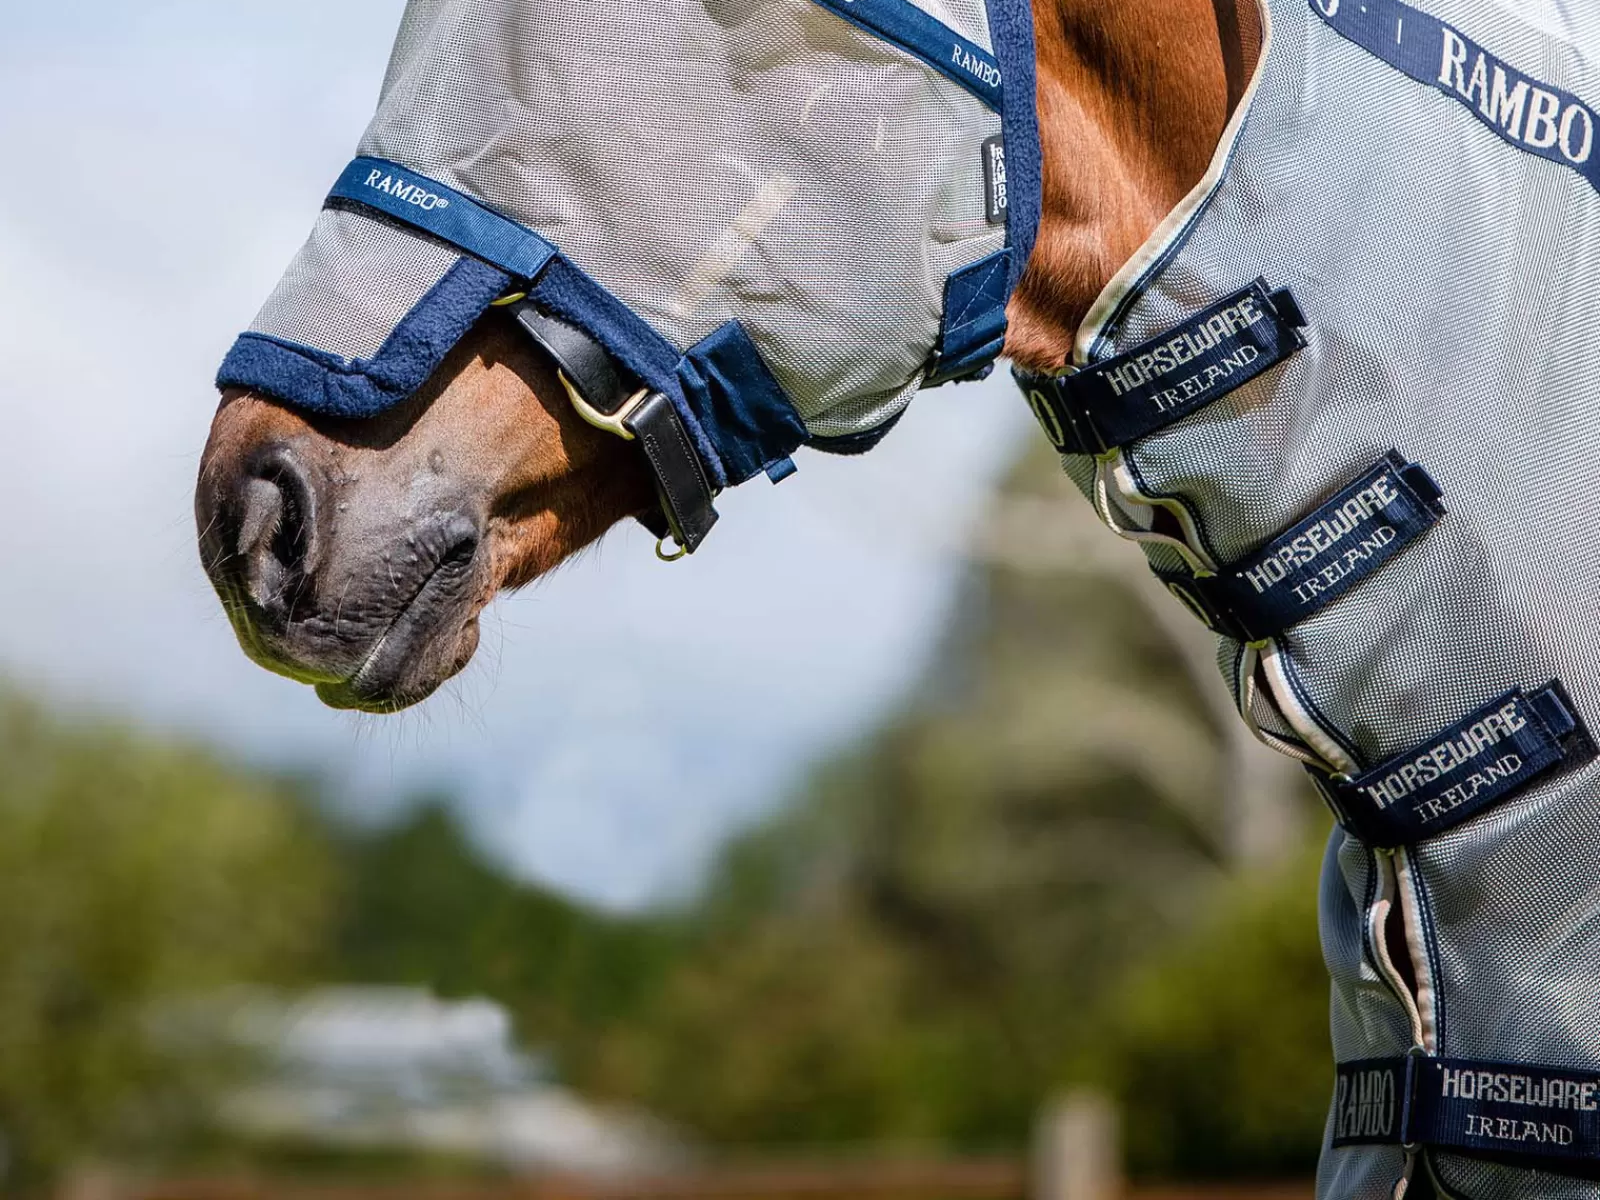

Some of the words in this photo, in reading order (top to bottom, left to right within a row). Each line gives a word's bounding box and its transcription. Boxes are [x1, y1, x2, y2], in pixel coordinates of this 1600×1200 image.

[1438, 27, 1592, 165] RAMBO
[1106, 296, 1263, 396] HORSEWARE
[1150, 344, 1259, 413] IRELAND
[1246, 475, 1398, 593] HORSEWARE
[1292, 525, 1396, 604] IRELAND
[1367, 702, 1526, 809] HORSEWARE
[1412, 754, 1522, 824] IRELAND
[1442, 1068, 1599, 1111] HORSEWARE
[1464, 1114, 1573, 1145] IRELAND
